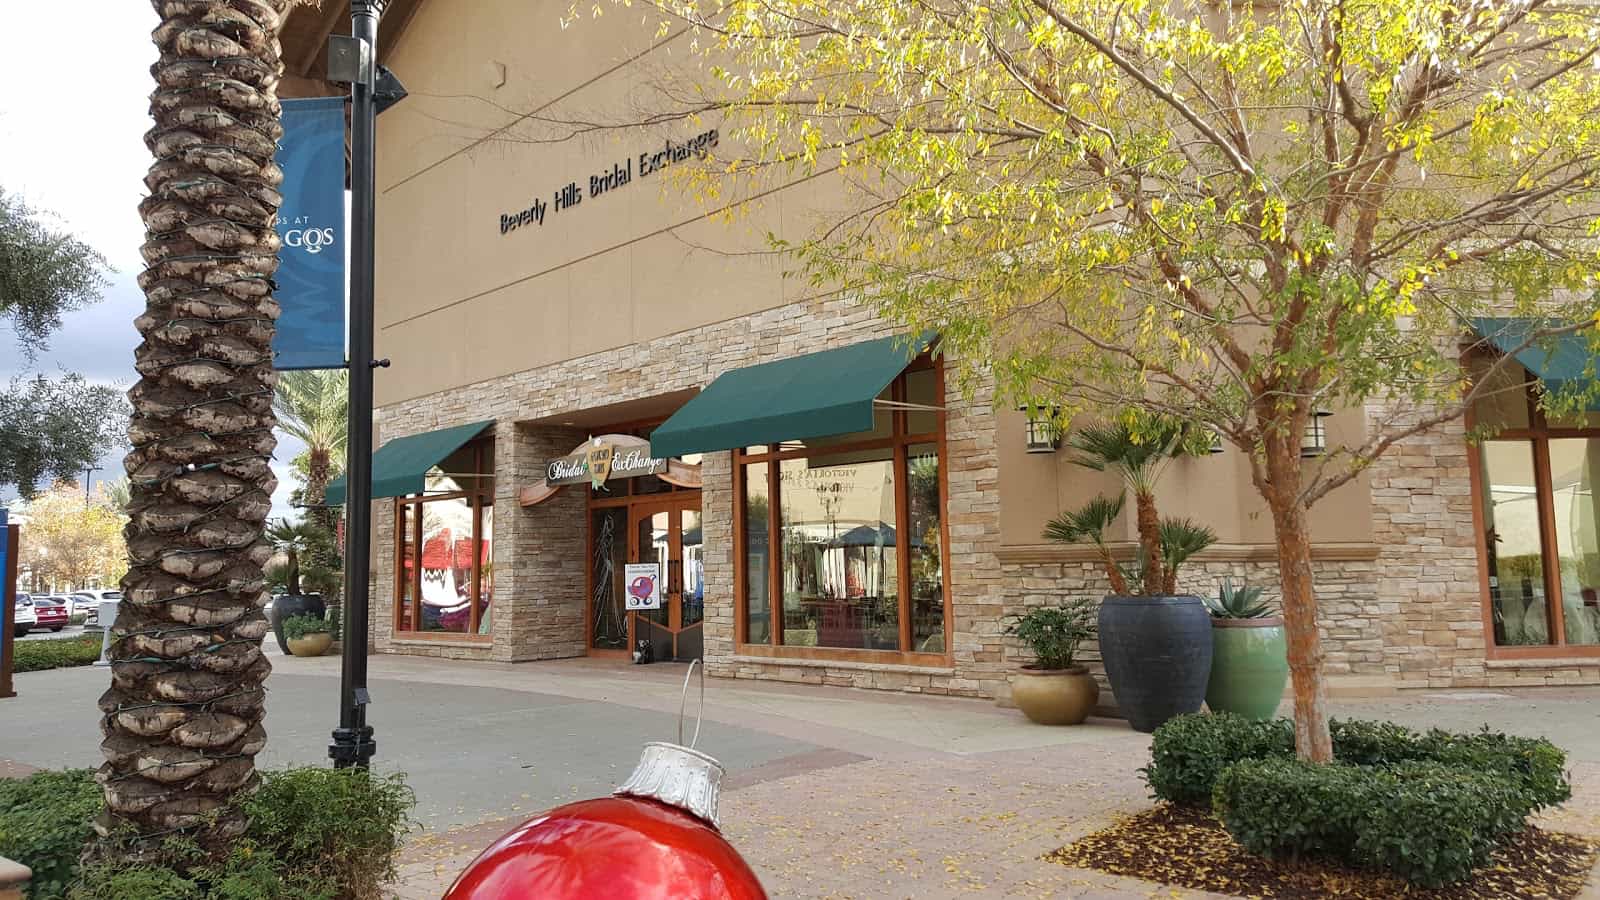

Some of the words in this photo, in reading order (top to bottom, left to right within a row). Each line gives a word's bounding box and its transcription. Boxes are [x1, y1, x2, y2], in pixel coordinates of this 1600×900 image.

[499, 198, 547, 235] Beverly
[554, 182, 582, 213] Hills
[589, 158, 631, 198] Bridal
[639, 129, 719, 177] Exchange
[294, 215, 309, 225] AT
[280, 227, 334, 254] GOS
[548, 458, 587, 480] Bridal
